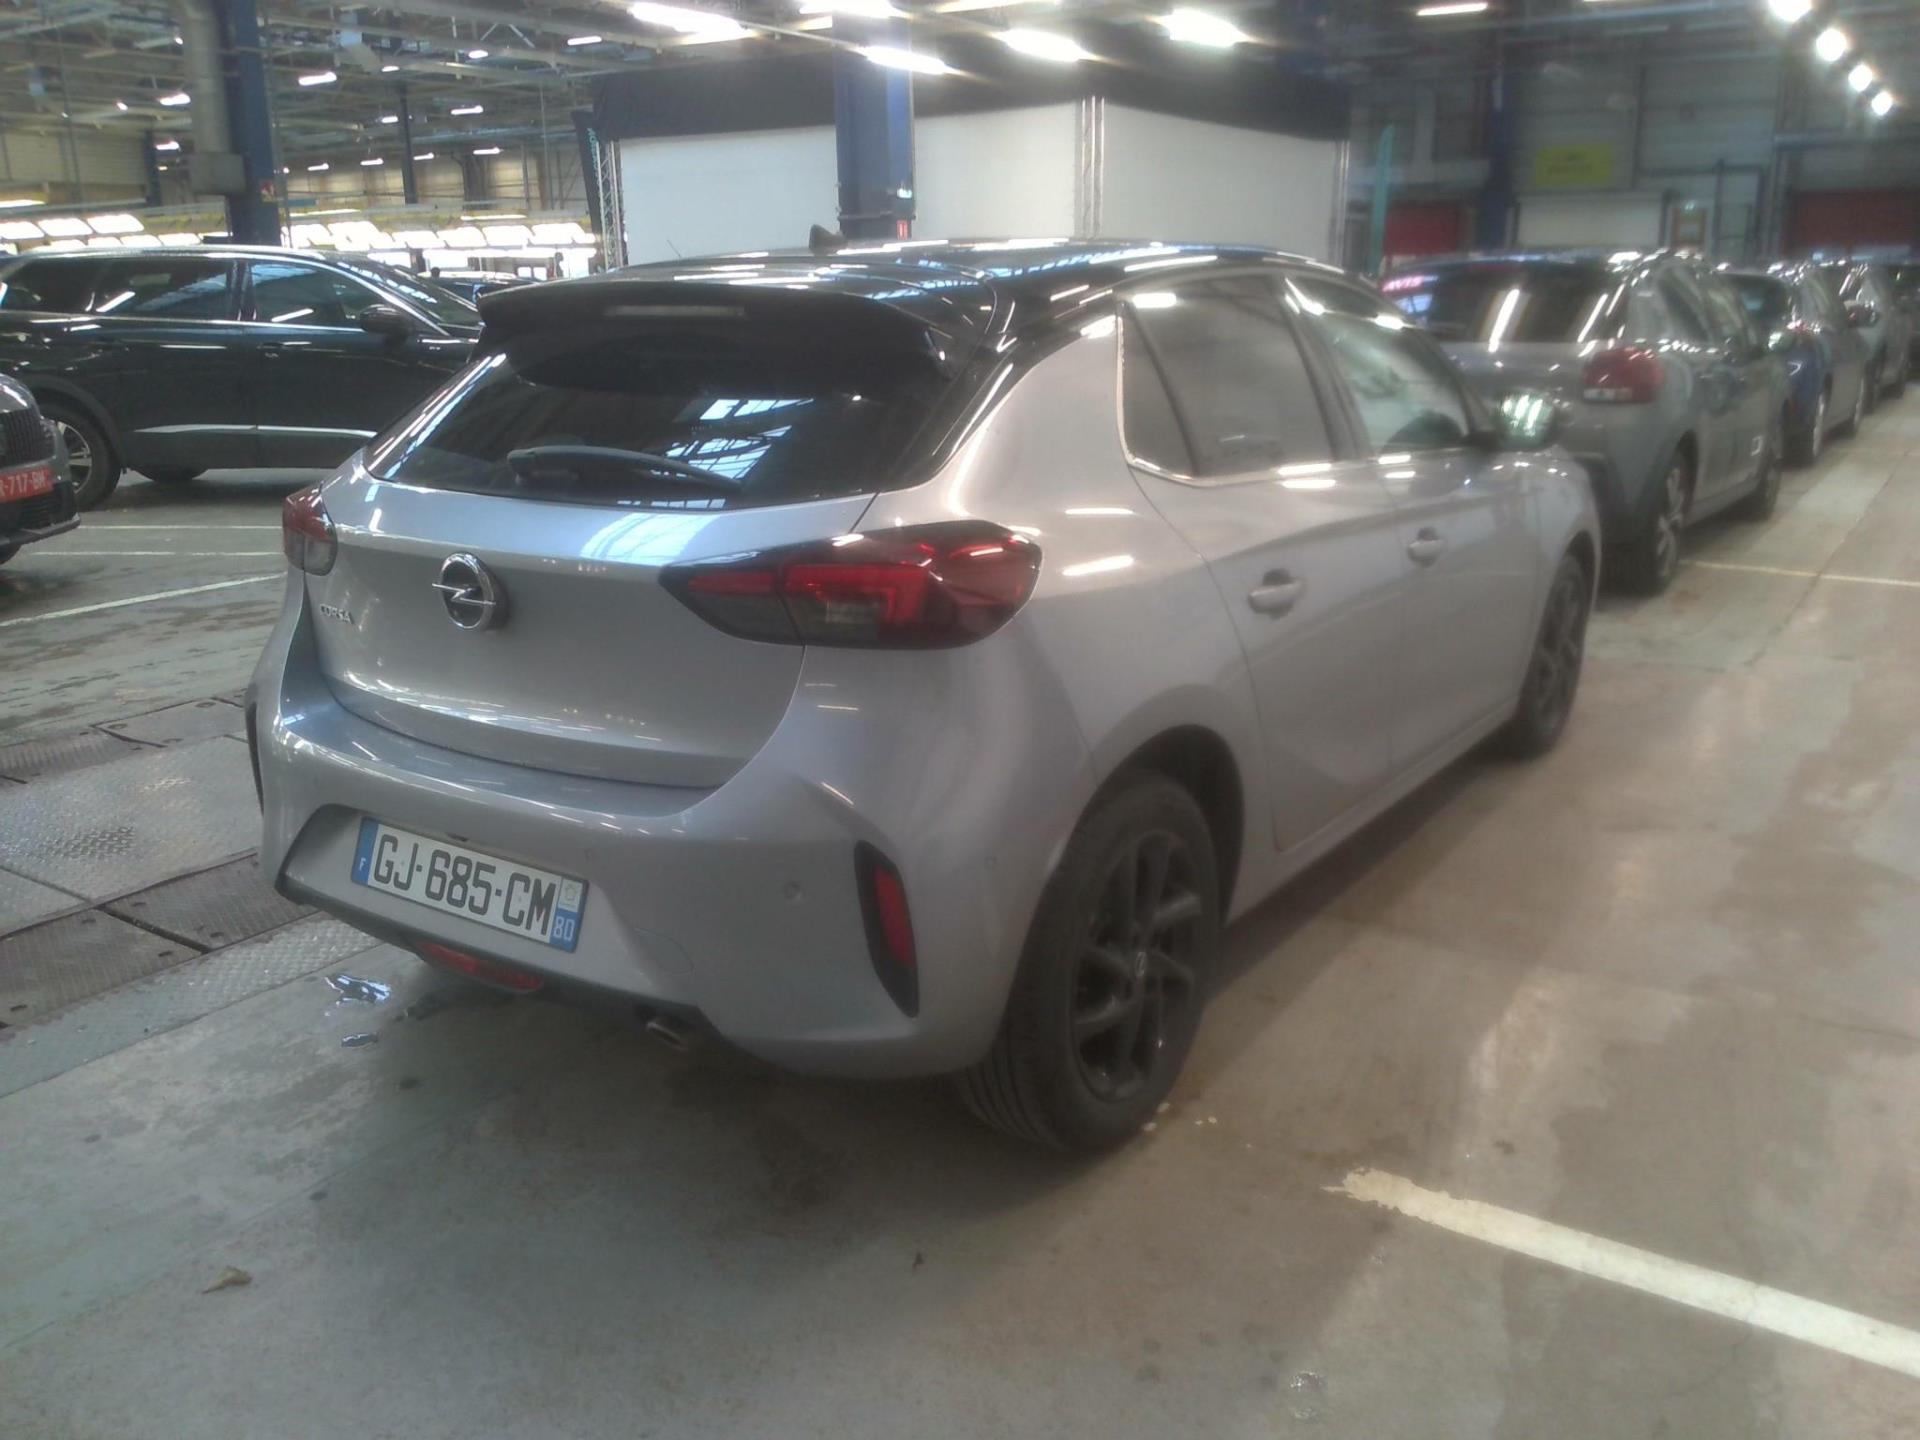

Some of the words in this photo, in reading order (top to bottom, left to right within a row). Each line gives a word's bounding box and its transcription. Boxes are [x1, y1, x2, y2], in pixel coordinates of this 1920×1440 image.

[358, 857, 367, 872] F
[373, 833, 557, 937] GJ-685-CM
[552, 915, 577, 943] 80
